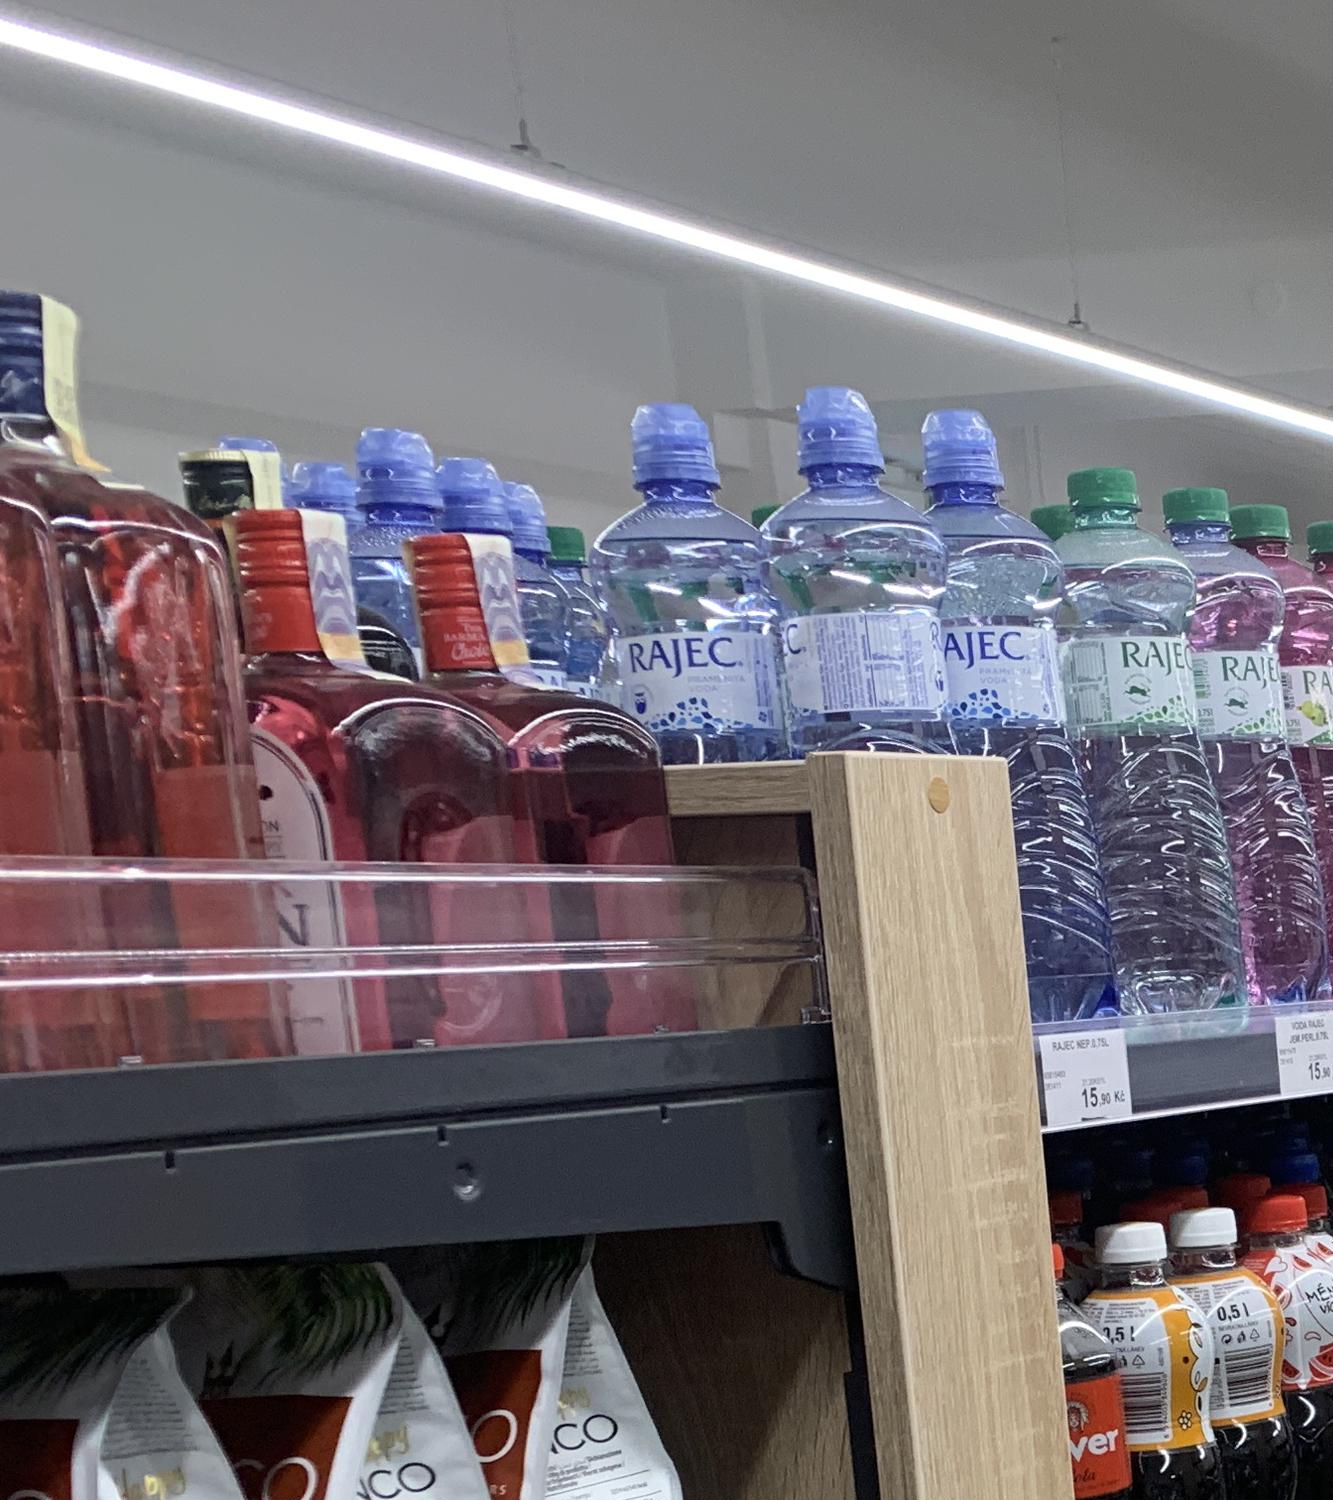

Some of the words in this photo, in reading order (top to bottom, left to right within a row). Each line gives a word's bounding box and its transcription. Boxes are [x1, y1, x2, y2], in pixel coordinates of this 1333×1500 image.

[629, 634, 736, 676] RAJEC
[943, 630, 1024, 669] AJEC
[1308, 1062, 1331, 1081] 15,90
[1081, 1086, 1112, 1109] 15,90
[1113, 1089, 1126, 1104] Kč
[1216, 1304, 1241, 1322] 0,5
[1070, 1428, 1118, 1463] ver
